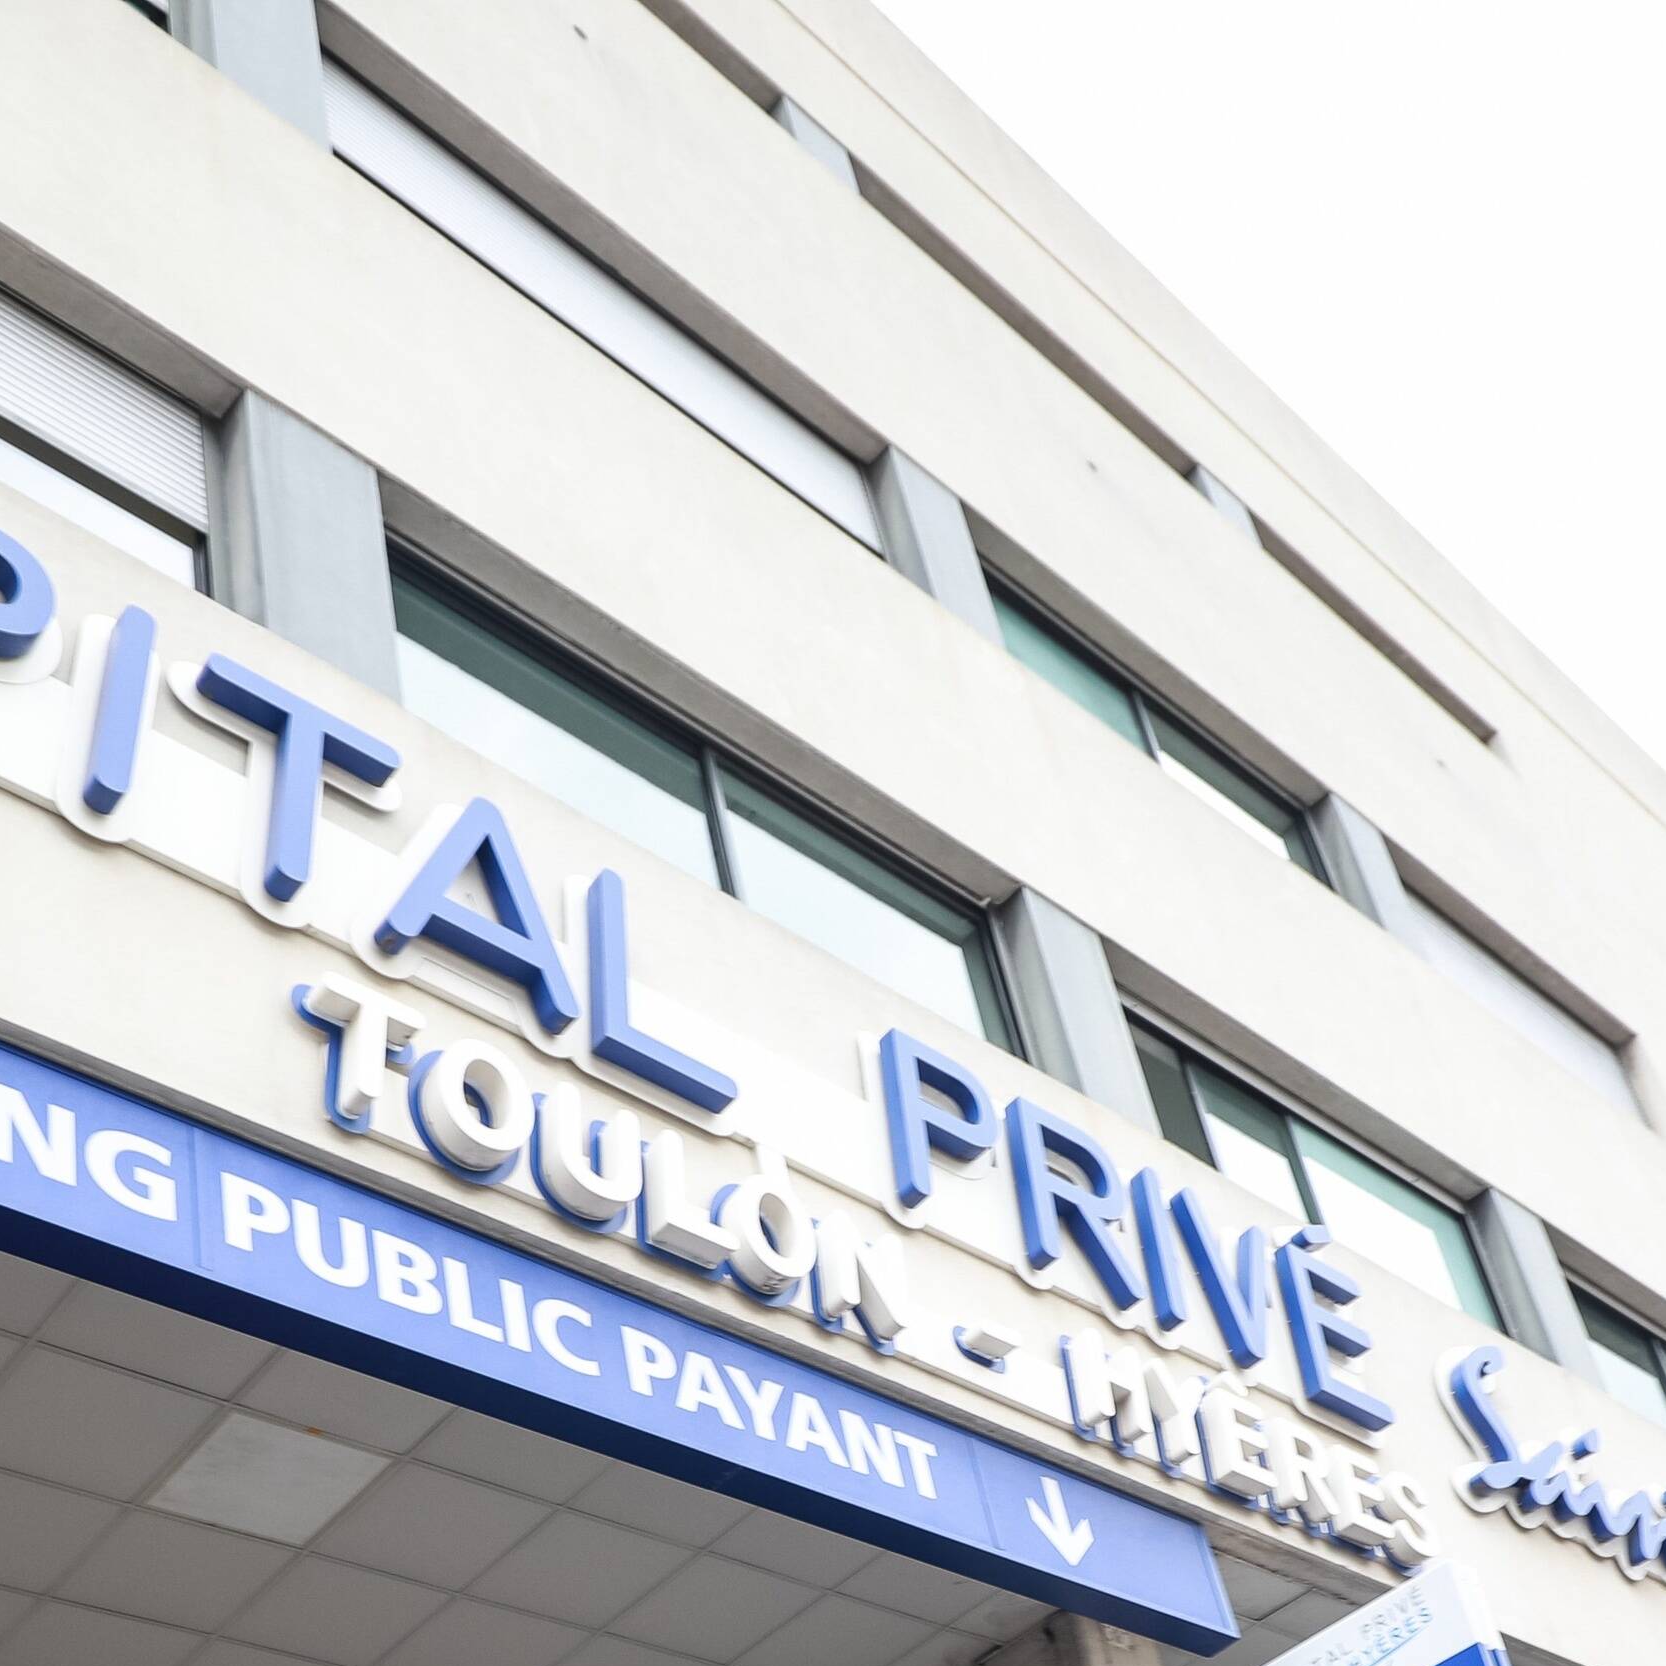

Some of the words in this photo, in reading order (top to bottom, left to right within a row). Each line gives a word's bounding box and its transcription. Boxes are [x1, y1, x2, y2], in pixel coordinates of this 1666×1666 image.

[220, 1172, 600, 1377] PUBLIC
[620, 1325, 941, 1499] PAYANT
[293, 977, 909, 1352] TOULON
[880, 1026, 1394, 1431] PRIVÉ
